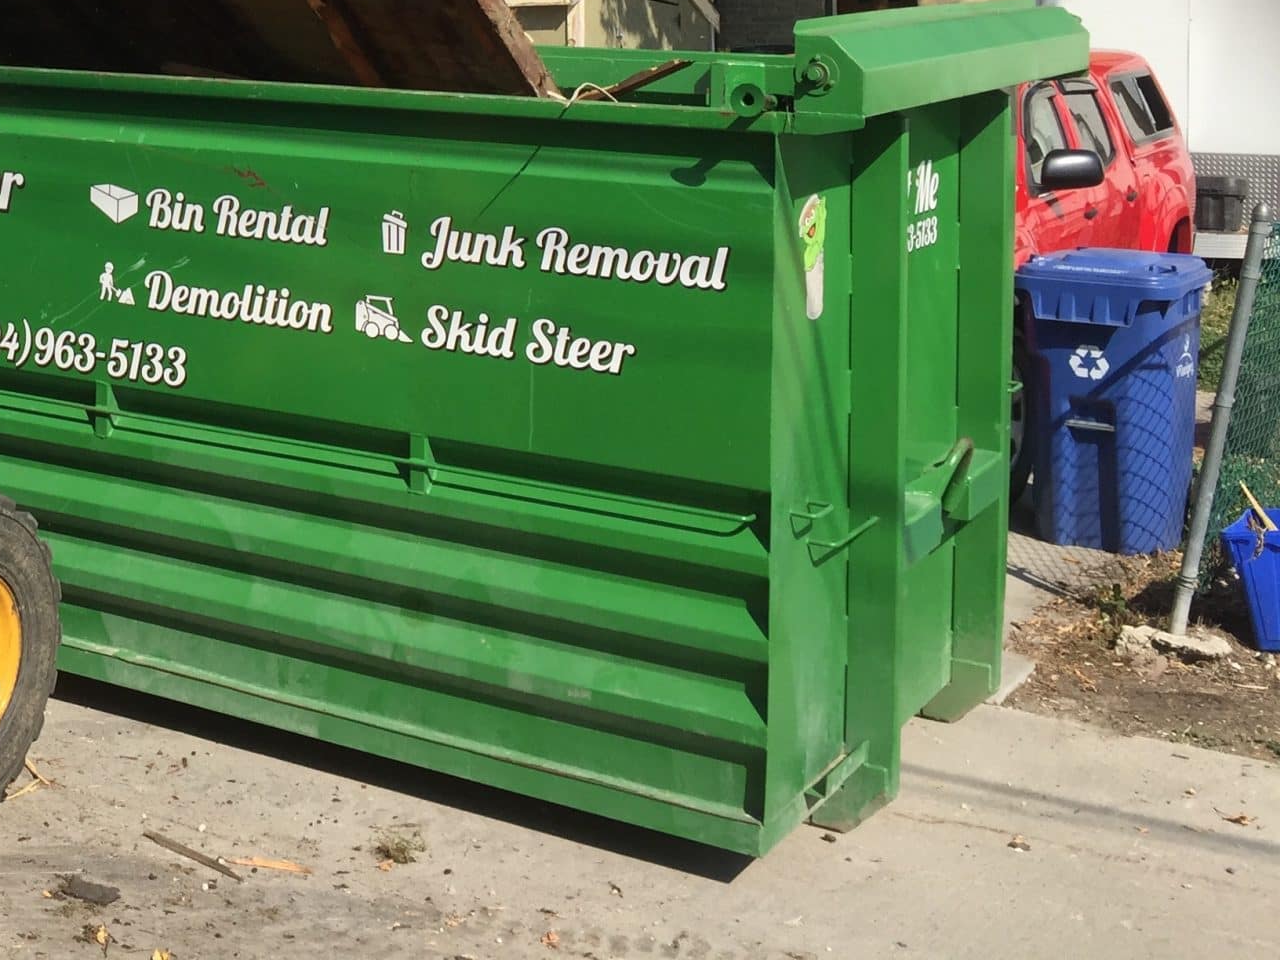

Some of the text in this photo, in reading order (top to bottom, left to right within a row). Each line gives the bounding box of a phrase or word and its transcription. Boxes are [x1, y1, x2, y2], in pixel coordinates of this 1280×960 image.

[146, 188, 330, 246] Bin Rental
[915, 159, 940, 215] Me
[421, 216, 730, 290] Junk Removal
[144, 270, 333, 333] Demolition
[420, 304, 636, 374] Skid Steer
